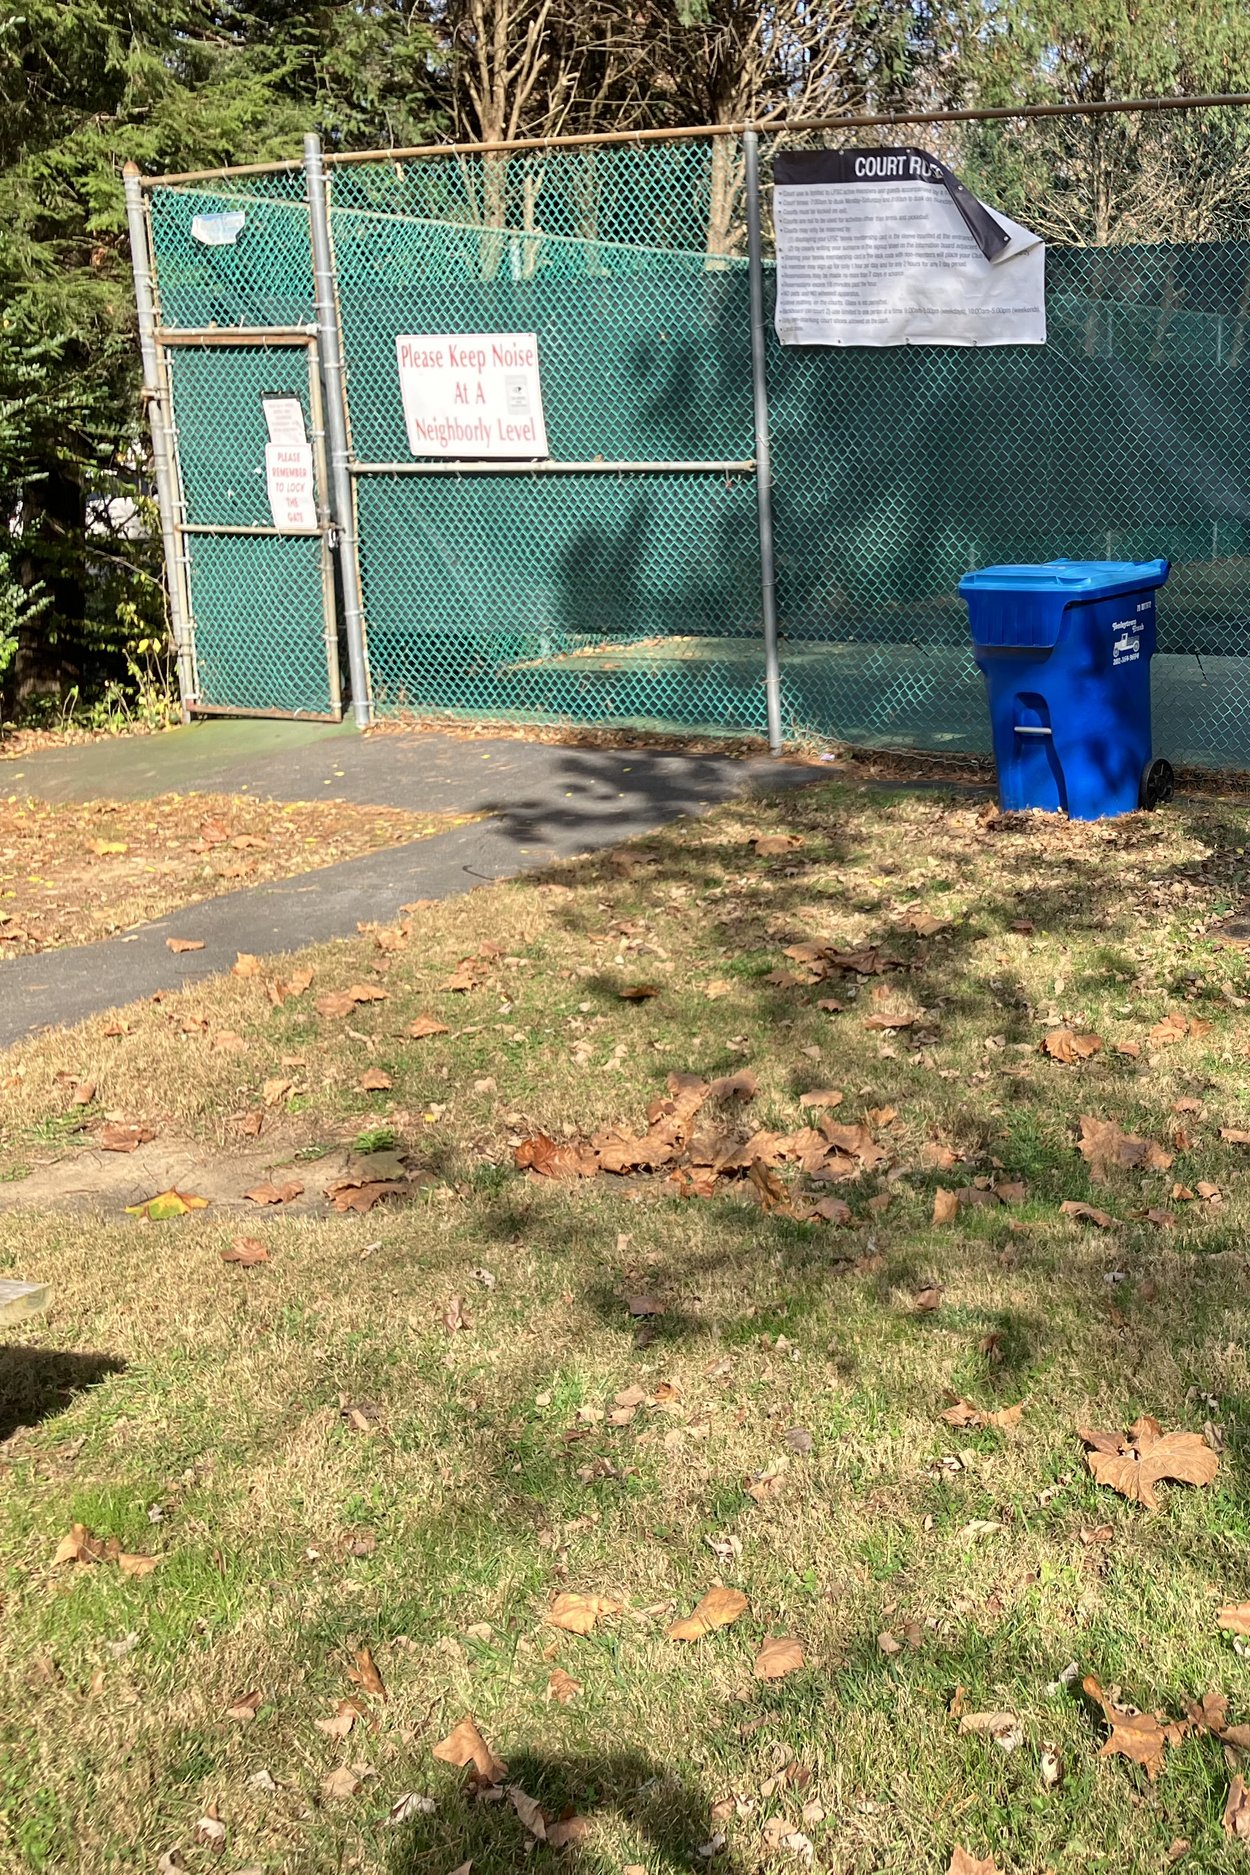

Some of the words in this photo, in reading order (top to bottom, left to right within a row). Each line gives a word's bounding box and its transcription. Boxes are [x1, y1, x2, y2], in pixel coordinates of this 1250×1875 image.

[855, 156, 906, 177] COURT
[401, 344, 444, 368] Please
[448, 344, 487, 374] Keep
[492, 343, 534, 367] Noise
[454, 381, 469, 405] At
[475, 382, 486, 405] A
[415, 416, 492, 448] Neighborly
[497, 417, 536, 441] Level
[277, 452, 301, 462] PLEASE
[272, 467, 307, 478] REMEMBER
[276, 482, 285, 493] TO
[287, 482, 306, 493] LOCK
[286, 497, 298, 508] THE
[287, 511, 305, 523] GATE
